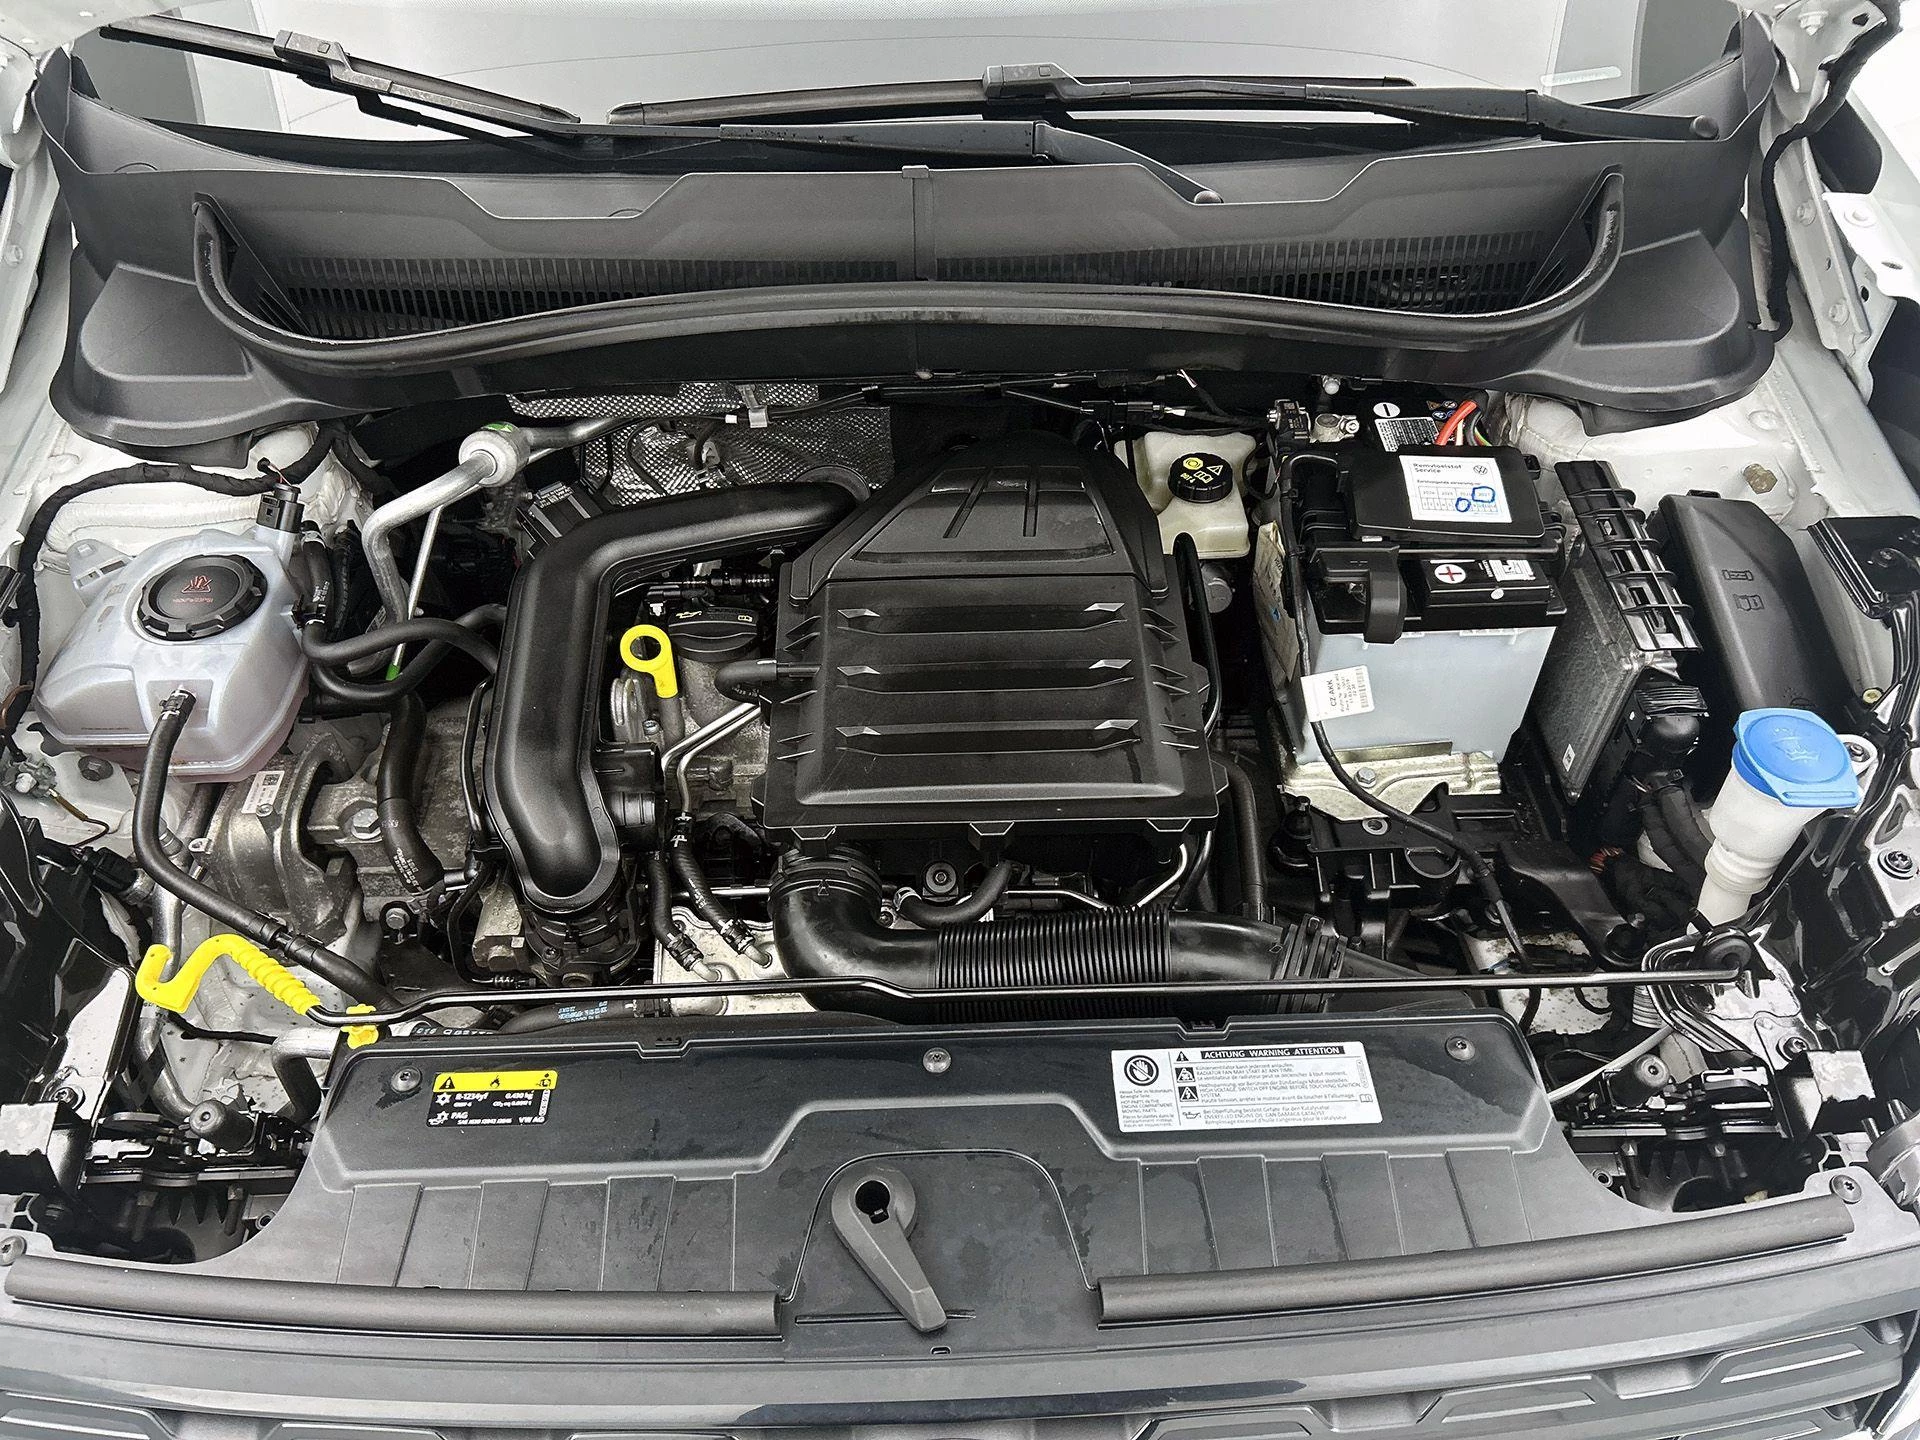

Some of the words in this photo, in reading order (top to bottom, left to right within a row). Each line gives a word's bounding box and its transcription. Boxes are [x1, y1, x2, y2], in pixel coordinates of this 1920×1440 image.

[1204, 1050, 1246, 1058] ACHTUNG
[1249, 1048, 1291, 1057] WARNING
[1294, 1046, 1340, 1055] ATTENTION
